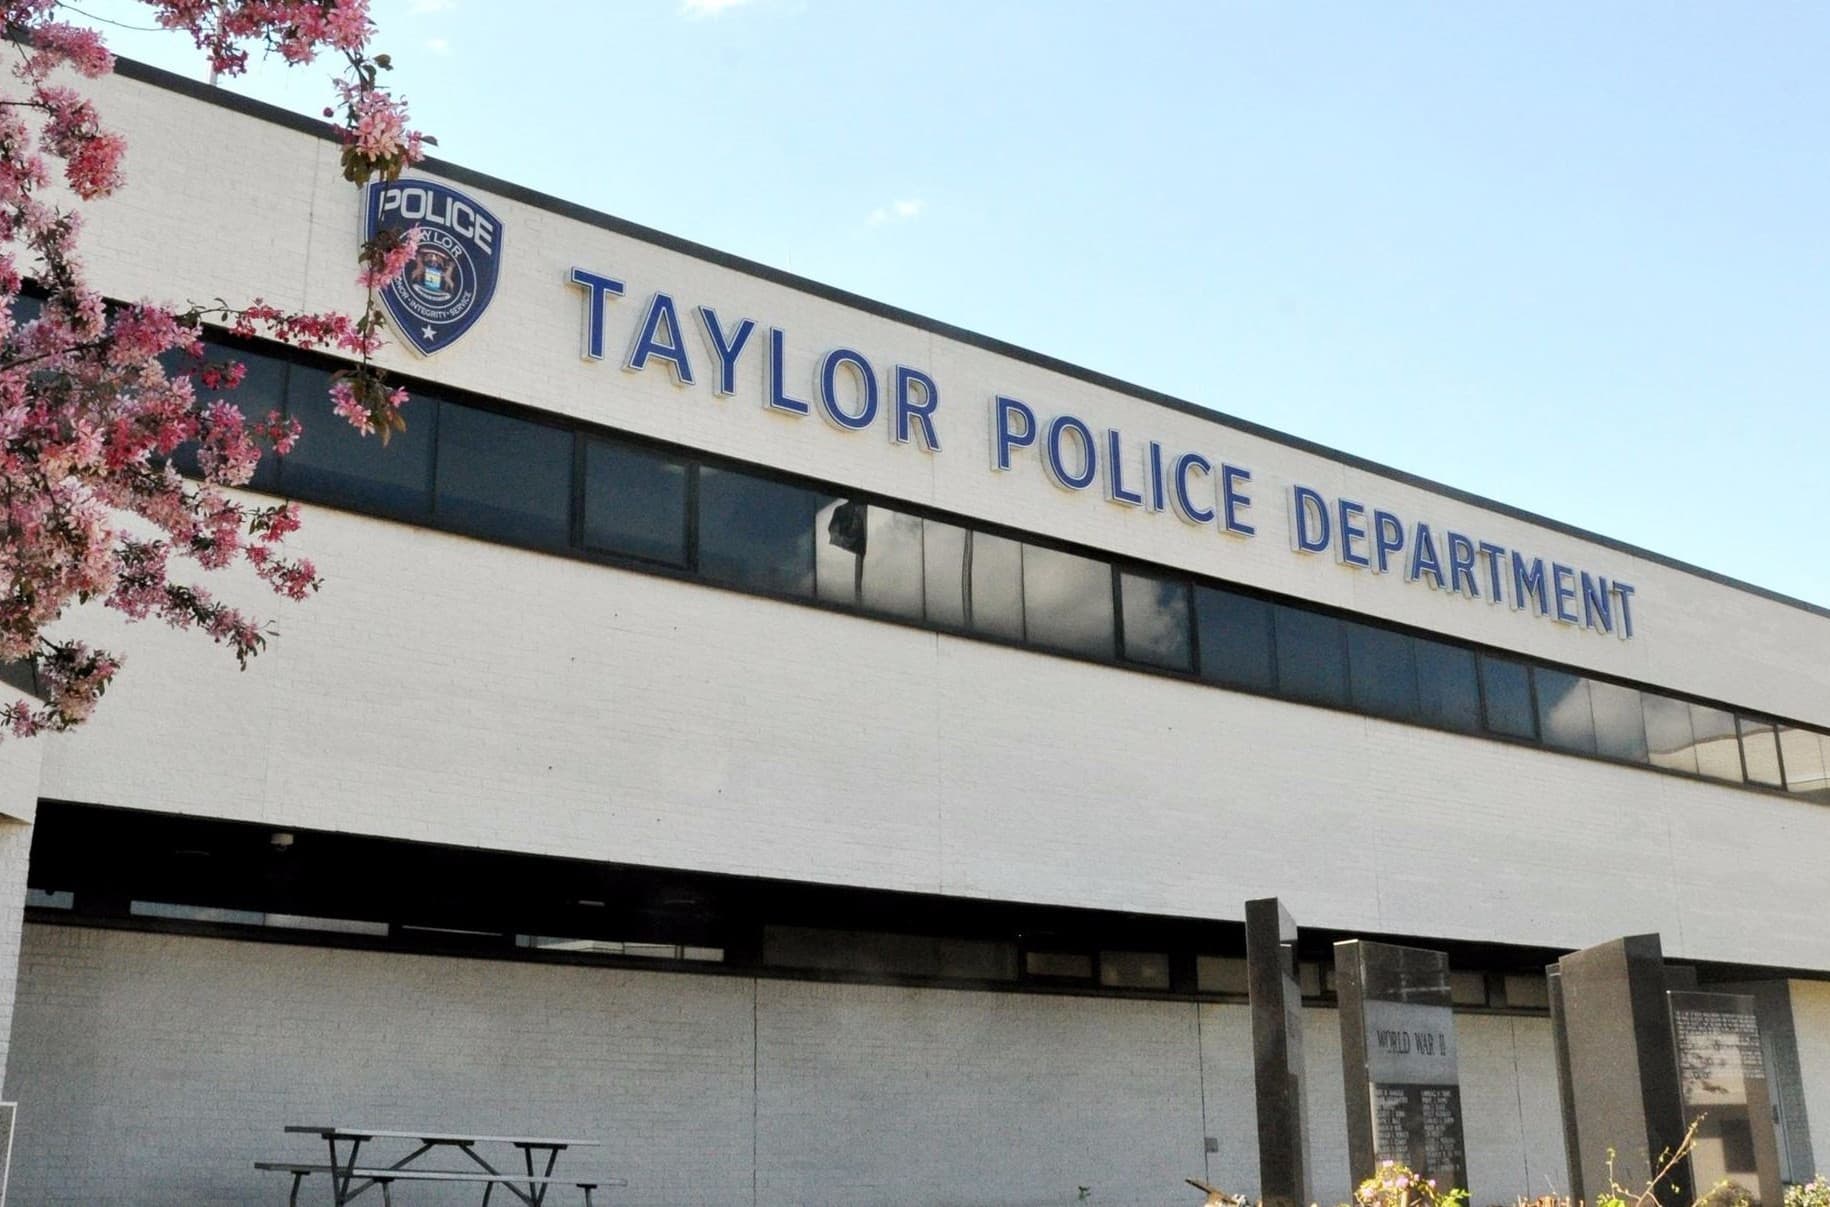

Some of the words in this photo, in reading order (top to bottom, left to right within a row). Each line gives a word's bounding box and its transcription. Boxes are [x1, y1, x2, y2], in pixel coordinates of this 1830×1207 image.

[379, 188, 493, 255] POLICE
[411, 230, 462, 257] AYLOR
[409, 300, 447, 318] INTEGRITY
[450, 290, 471, 316] SERVICE
[569, 266, 942, 452] TAYLOR
[990, 394, 1255, 537] POLICE
[1287, 484, 1636, 641] DEPARTMENT
[1376, 1030, 1410, 1054] WORLD
[1414, 1032, 1434, 1056] WAR
[1439, 1033, 1446, 1056] II
